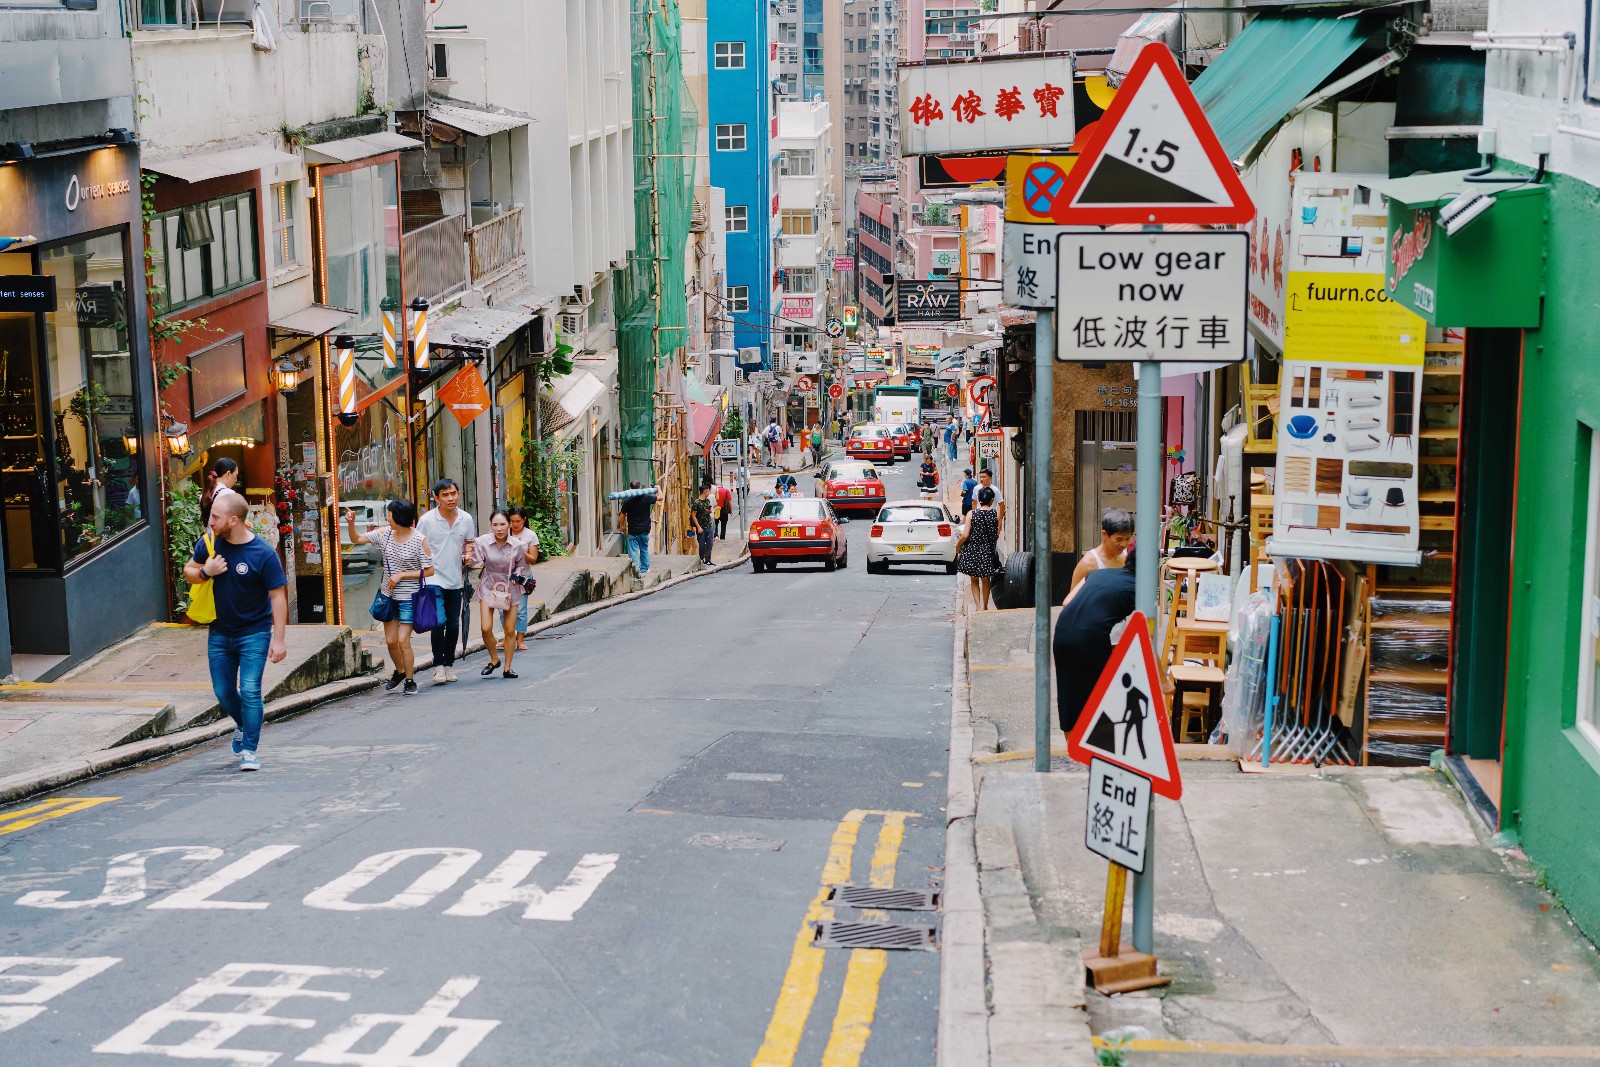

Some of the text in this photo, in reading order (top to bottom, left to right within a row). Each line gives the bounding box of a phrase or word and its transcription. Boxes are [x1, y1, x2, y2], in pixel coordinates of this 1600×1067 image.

[1123, 127, 1180, 173] 1:5
[81, 180, 130, 200] orient senses
[1023, 233, 1056, 255] En
[1079, 246, 1226, 277] Low gear
[1017, 265, 1056, 299] 終
[1119, 283, 1184, 301] now
[1307, 282, 1394, 302] fuurn.co
[908, 290, 950, 308] RAW
[1306, 306, 1334, 314] Furniture
[1335, 307, 1358, 316] Factory
[1073, 315, 1230, 349] 低波行車
[1101, 775, 1137, 807] End
[1091, 802, 1139, 856] 終止
[15, 845, 620, 921] SLOW
